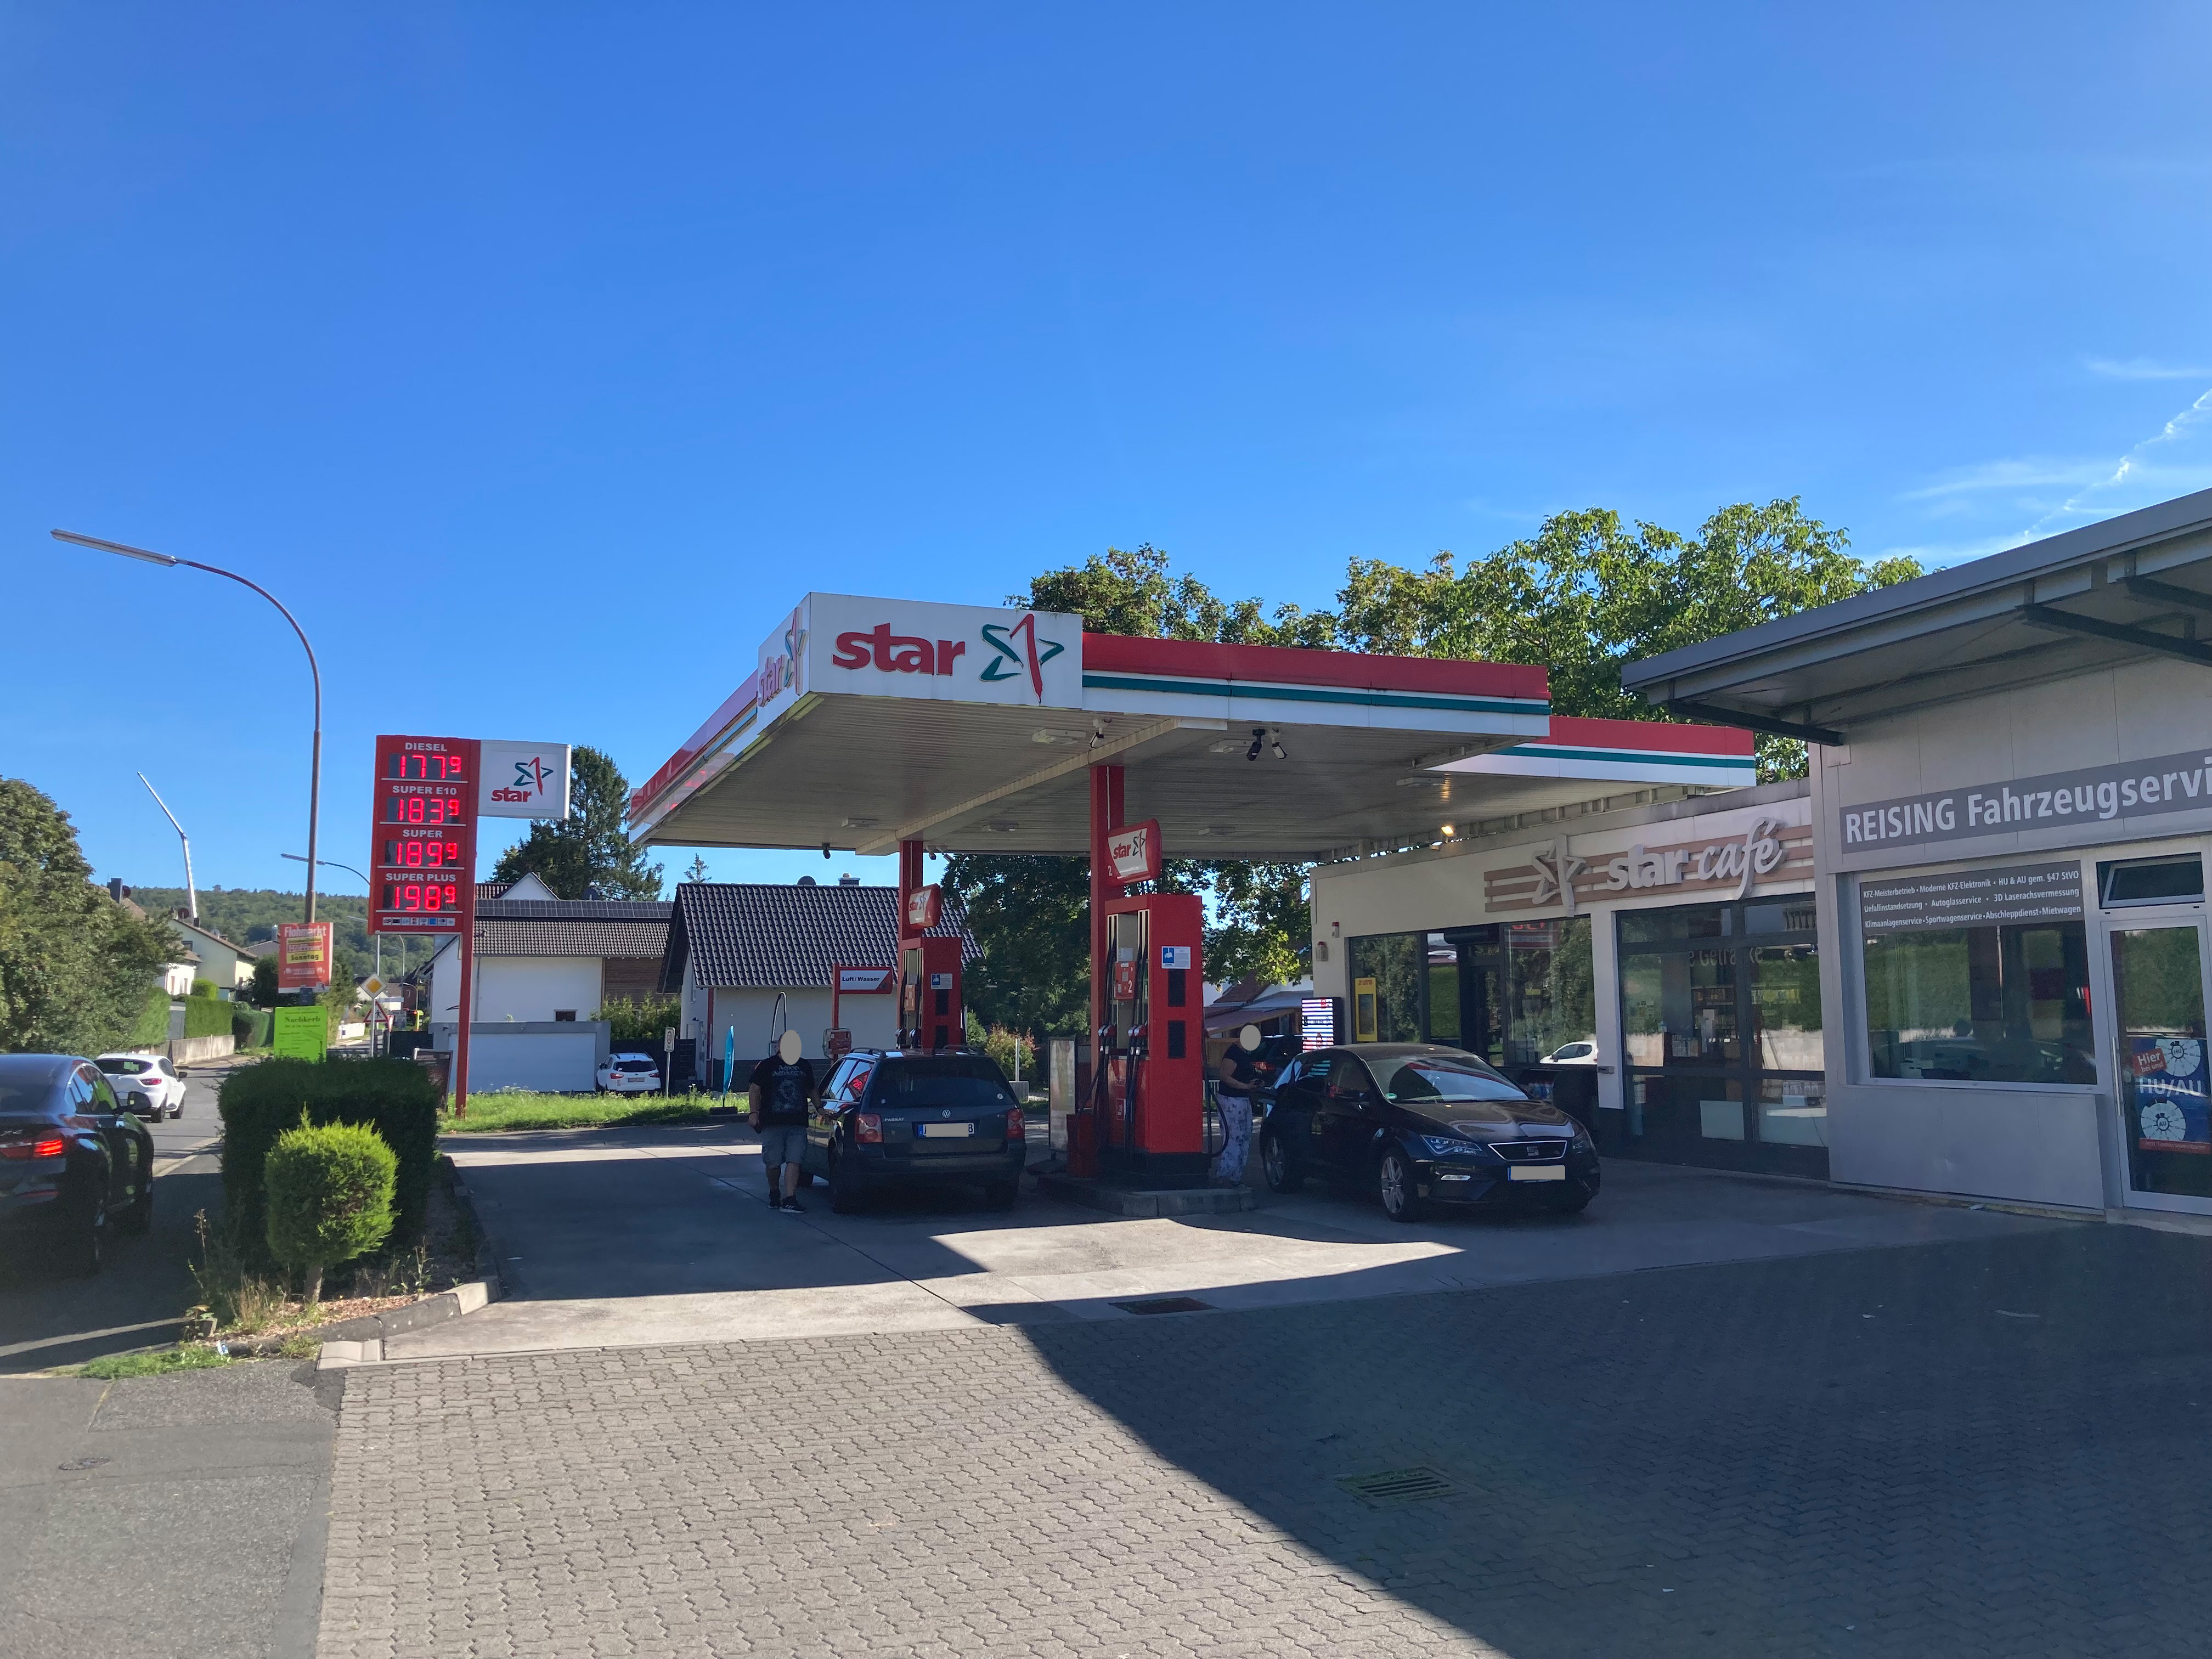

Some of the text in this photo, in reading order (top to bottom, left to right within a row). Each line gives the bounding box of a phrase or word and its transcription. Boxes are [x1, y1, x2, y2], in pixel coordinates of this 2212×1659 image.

[832, 623, 966, 676] star
[759, 654, 787, 707] star
[405, 742, 448, 752] DIESEL
[392, 785, 457, 795] SUPER E10
[491, 787, 532, 803] star
[1846, 757, 2212, 844] REISING Fahrzeugservi
[403, 829, 443, 838] SUPER
[1113, 842, 1131, 860] star
[1605, 816, 1784, 901] star café
[386, 873, 456, 882] SUPER PLUS
[1107, 865, 1113, 877] 2
[1863, 885, 1915, 898] KFZ-Meisterbetrieb
[1920, 884, 1946, 894] Moderne
[1948, 878, 1991, 890] KFZ-Elektronik
[1999, 877, 2008, 886] HU
[2017, 876, 2027, 884] AU
[2028, 874, 2045, 885] gem.
[2047, 872, 2059, 883] §47
[2061, 870, 2079, 880] StVO
[1864, 888, 2079, 913] Unfallinstandsetzung Autoglasservice 3D Laserachsvermessung
[1865, 906, 2081, 928] Klimaanlagenservice Sportwagenservice Abschleppdienst Mietwagen
[284, 925, 327, 938] Flohmarkt
[1128, 980, 1132, 994] 2
[2137, 1052, 2160, 1066] Hier
[2139, 1077, 2202, 1097] HU/AU
